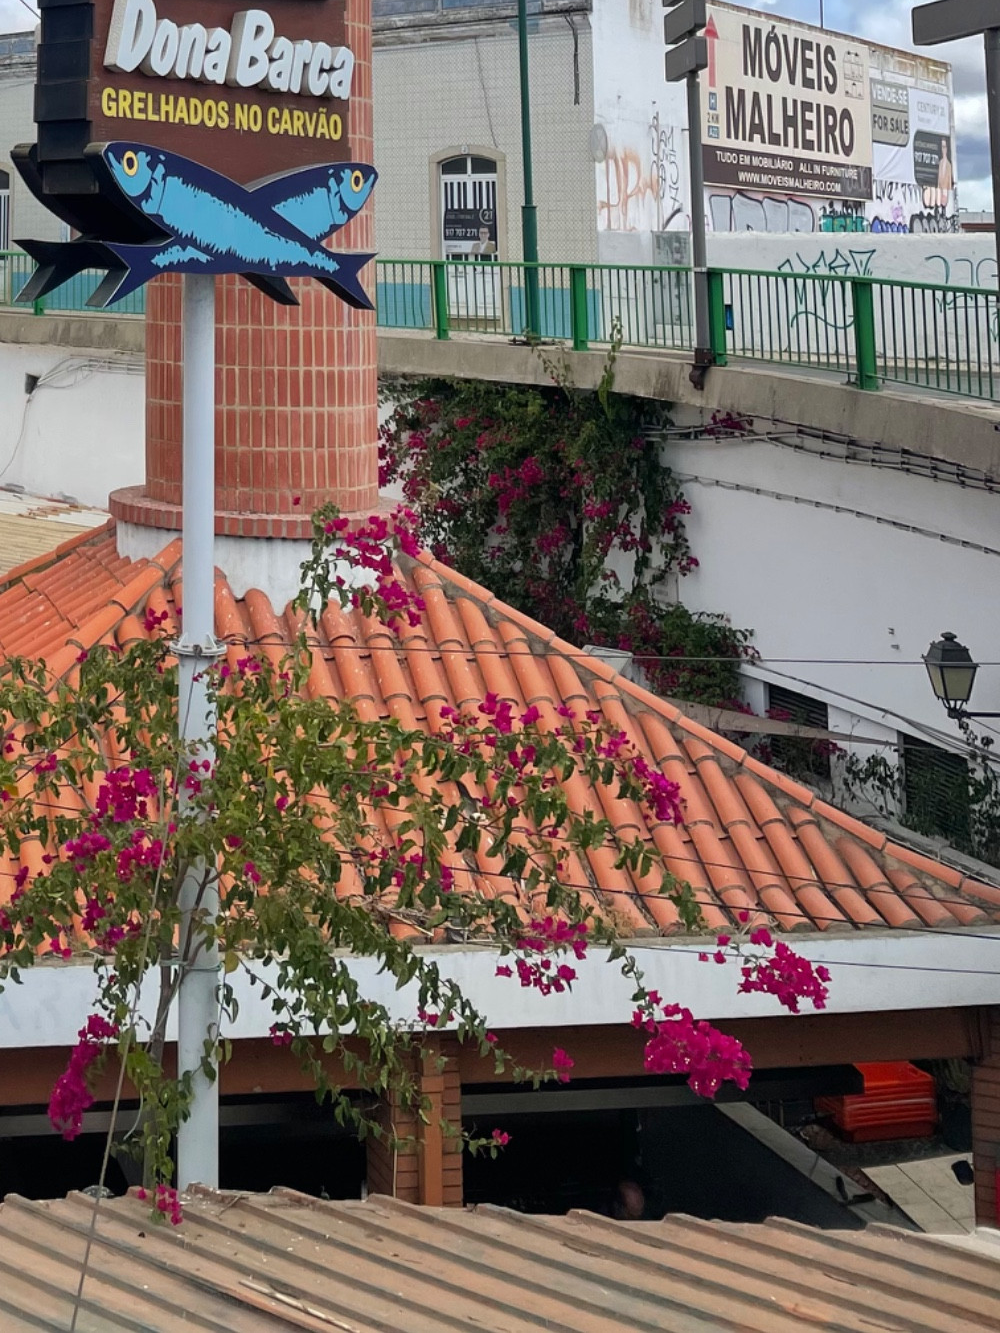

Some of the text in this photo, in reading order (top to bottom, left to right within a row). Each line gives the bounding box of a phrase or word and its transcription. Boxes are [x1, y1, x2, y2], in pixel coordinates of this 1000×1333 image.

[228, 9, 355, 100] Barca
[742, 24, 838, 95] MÓVEIS
[871, 82, 908, 105] VENDE-SE
[101, 87, 342, 141] GRELHADOS NO CARVÃO
[725, 85, 855, 157] MALHEIRO
[873, 114, 888, 130] FOR
[890, 117, 909, 134] SALE
[715, 151, 858, 180] TUDO EM MOBILIÁRIO ALL IN FURNITURE
[738, 171, 841, 193] WWW.MOVEISMALHEIRO.COM
[483, 210, 493, 220] 21
